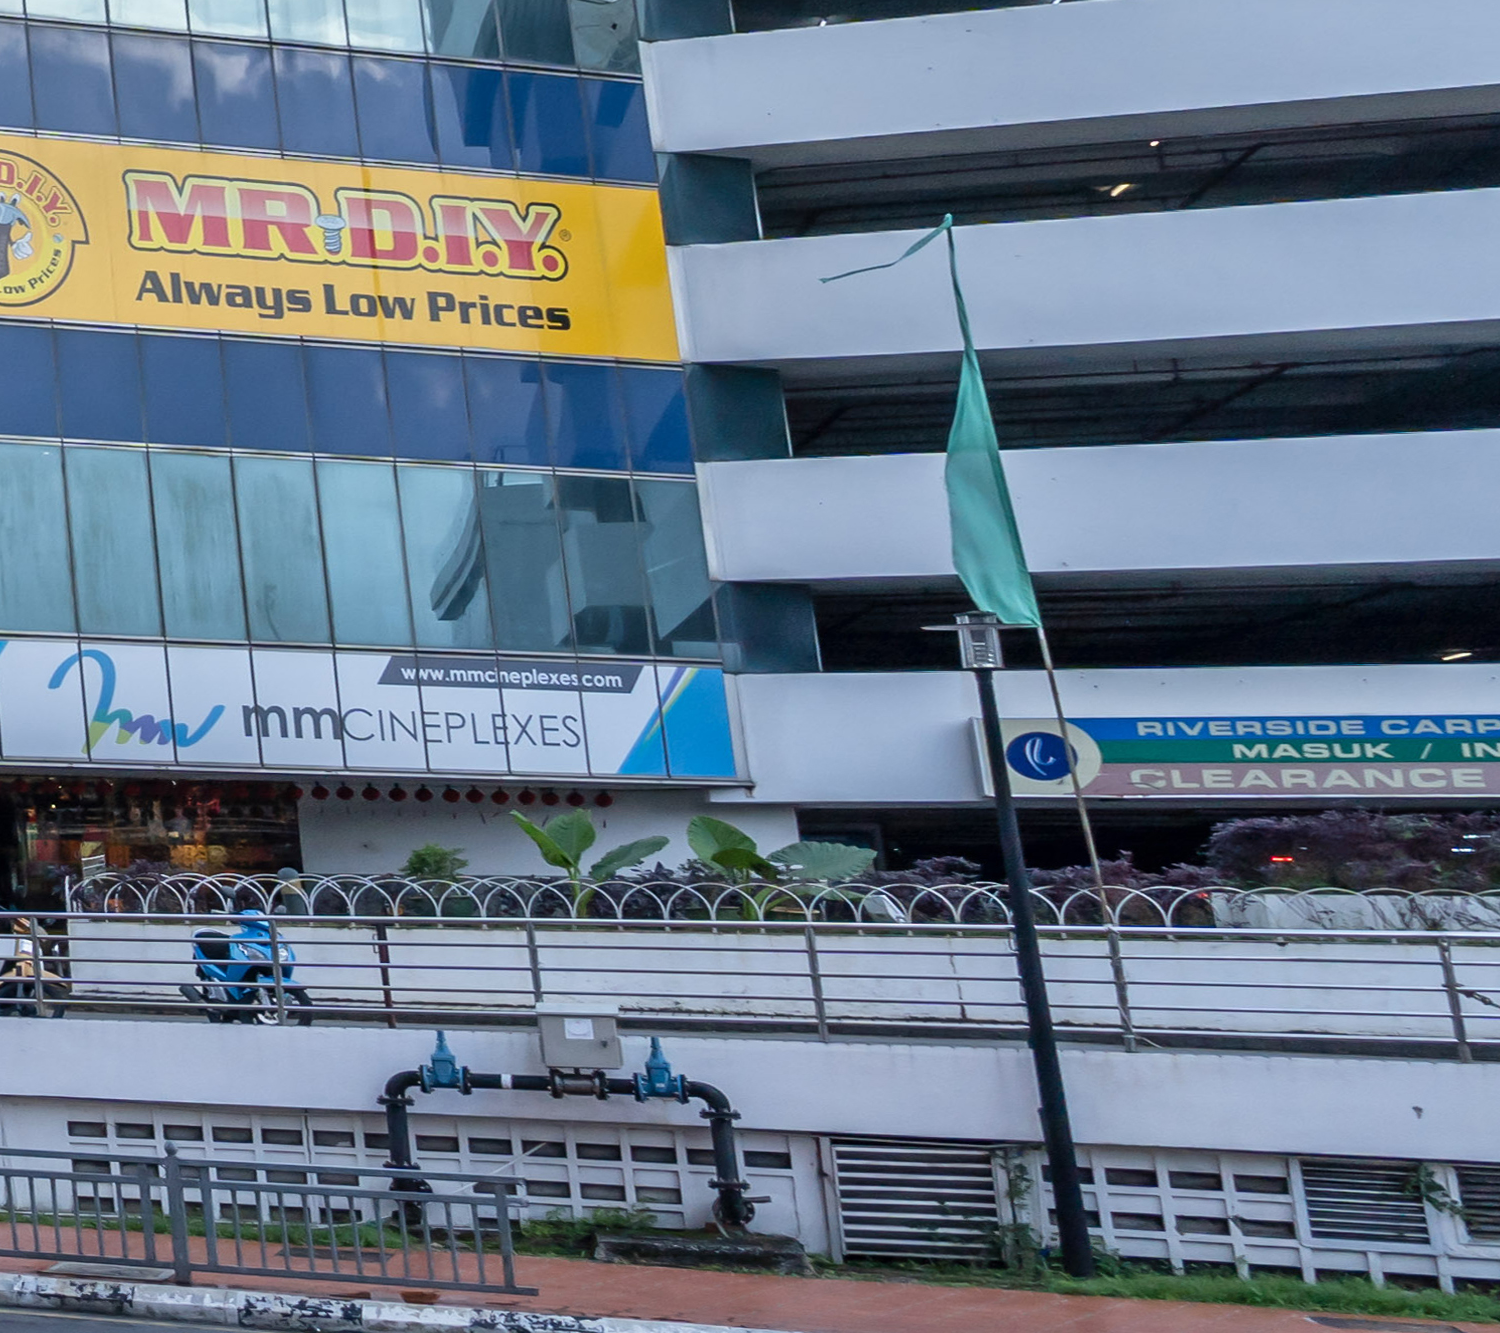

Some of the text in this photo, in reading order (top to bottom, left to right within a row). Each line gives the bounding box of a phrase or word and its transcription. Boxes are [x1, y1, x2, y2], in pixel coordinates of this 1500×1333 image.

[28, 248, 62, 290] Prices
[135, 270, 571, 331] Always Low Prices
[401, 666, 623, 689] www.mmcineplexescom
[1136, 720, 1367, 737] RIVERSIDE
[1232, 742, 1395, 759] MASUK
[1129, 767, 1487, 790] CLEARANCE
